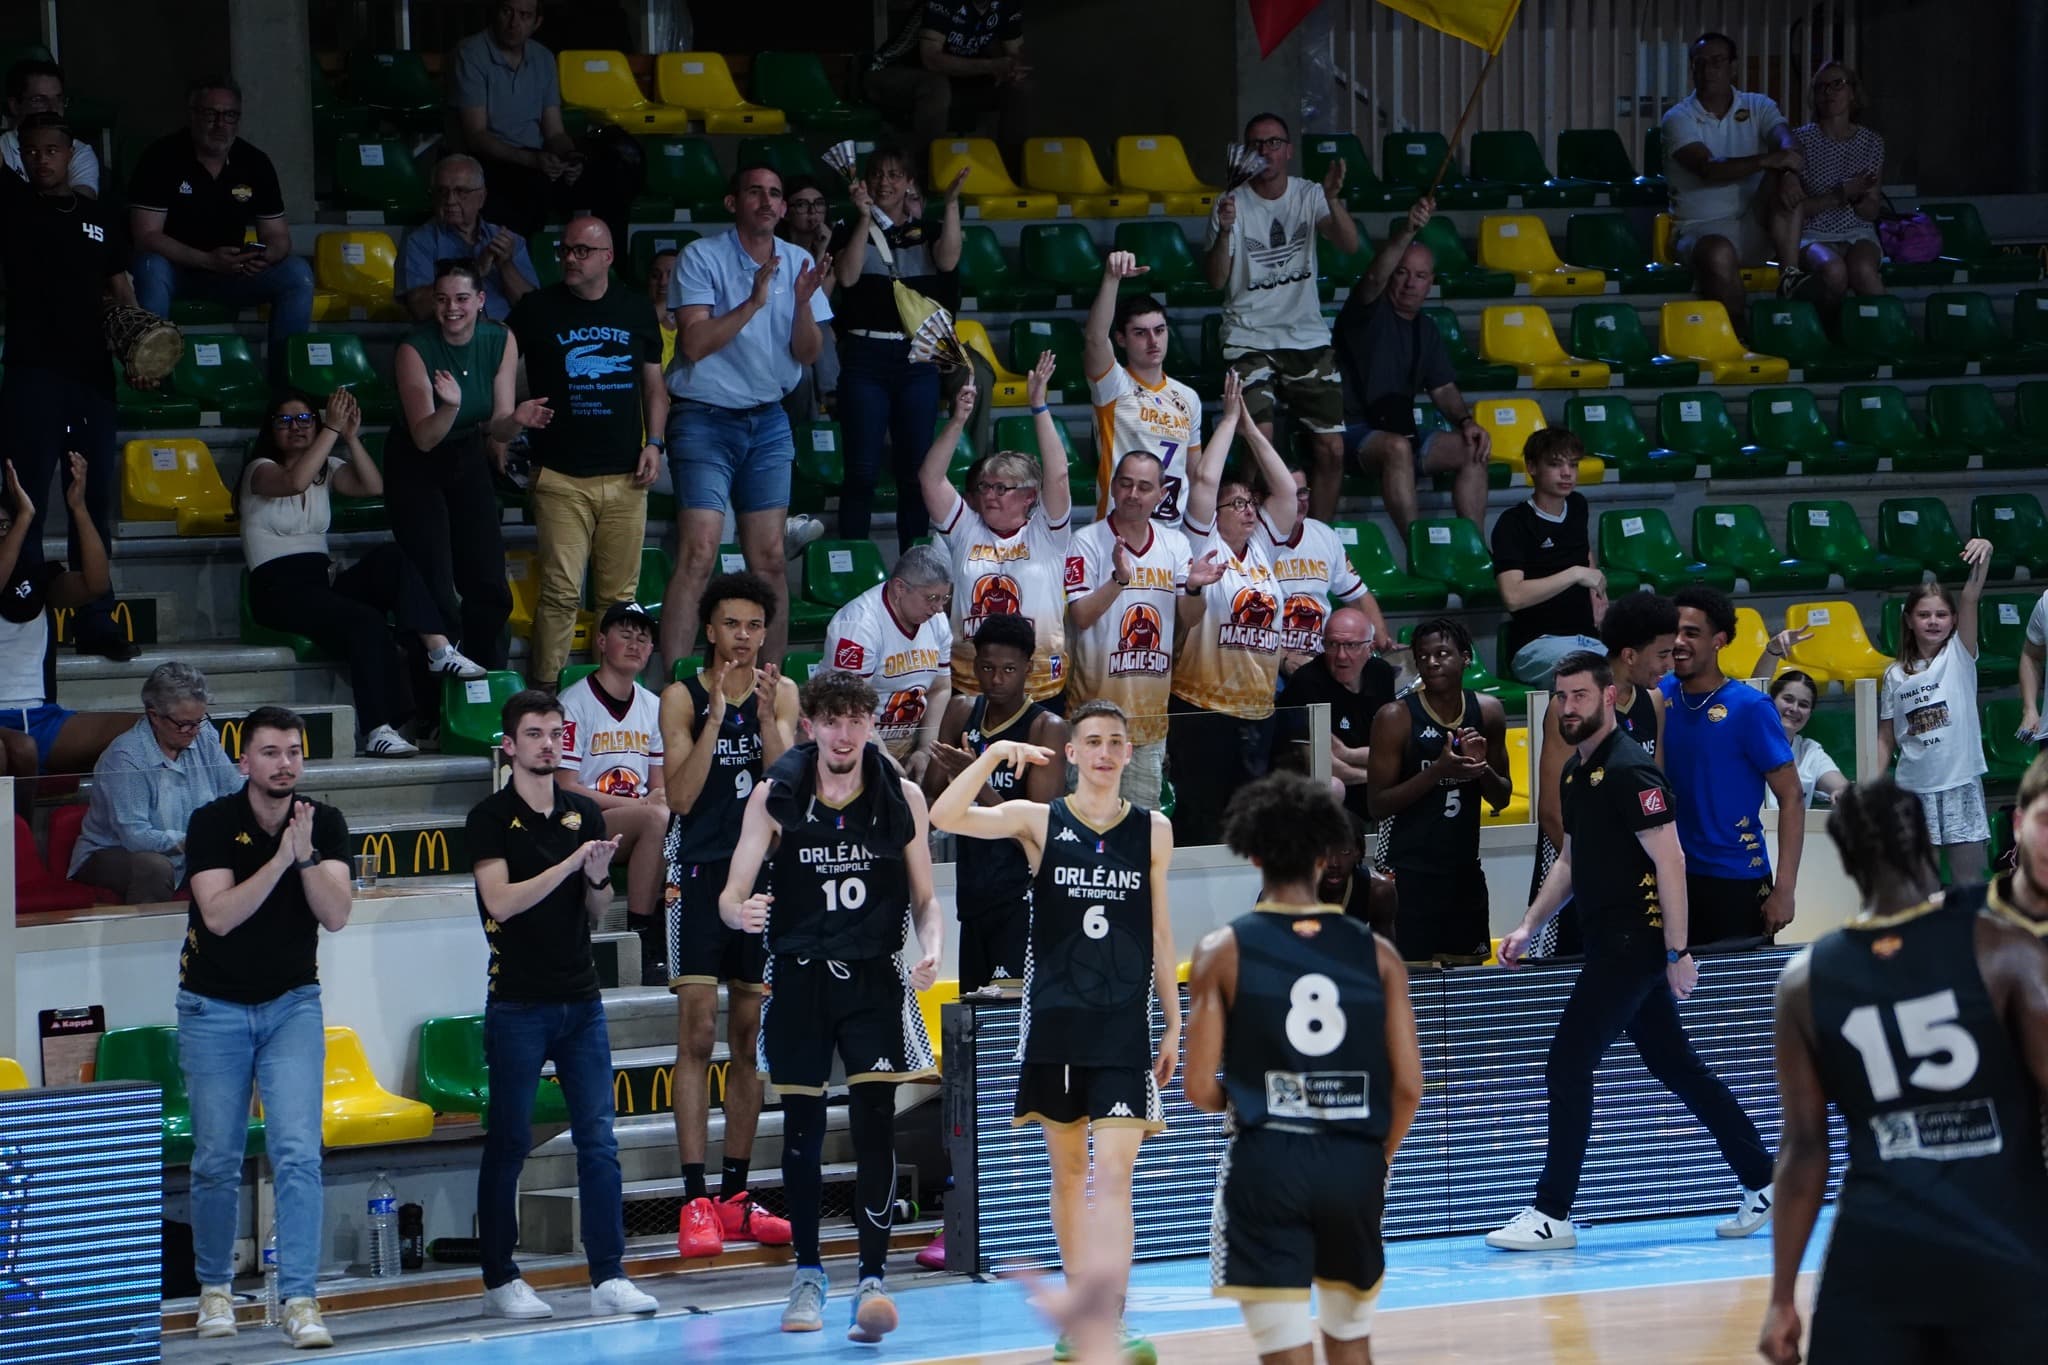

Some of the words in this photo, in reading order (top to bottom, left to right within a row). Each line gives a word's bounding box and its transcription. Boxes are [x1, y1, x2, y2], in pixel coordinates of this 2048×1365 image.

[82, 221, 105, 243] 45
[556, 326, 631, 346] LACOSTE
[1160, 441, 1179, 471] 7
[1129, 567, 1175, 590] LEANS
[1273, 558, 1328, 580] RLEANS
[884, 650, 939, 676] ORLEAN
[1900, 689, 1920, 701] FINAL
[1924, 737, 1941, 747] EVA
[735, 769, 753, 799] 9
[1443, 788, 1462, 818] 5
[799, 841, 880, 863] ORLÉAN
[816, 862, 871, 874] MÉTROPOLE
[1054, 865, 1142, 891] ORLÉANS
[821, 877, 867, 912] 10
[1067, 886, 1127, 901] MÉTROPOLE
[1082, 904, 1109, 940] 6
[62, 1019, 94, 1028] Kappa
[1285, 972, 1348, 1057] 8
[1840, 987, 1980, 1103] 15
